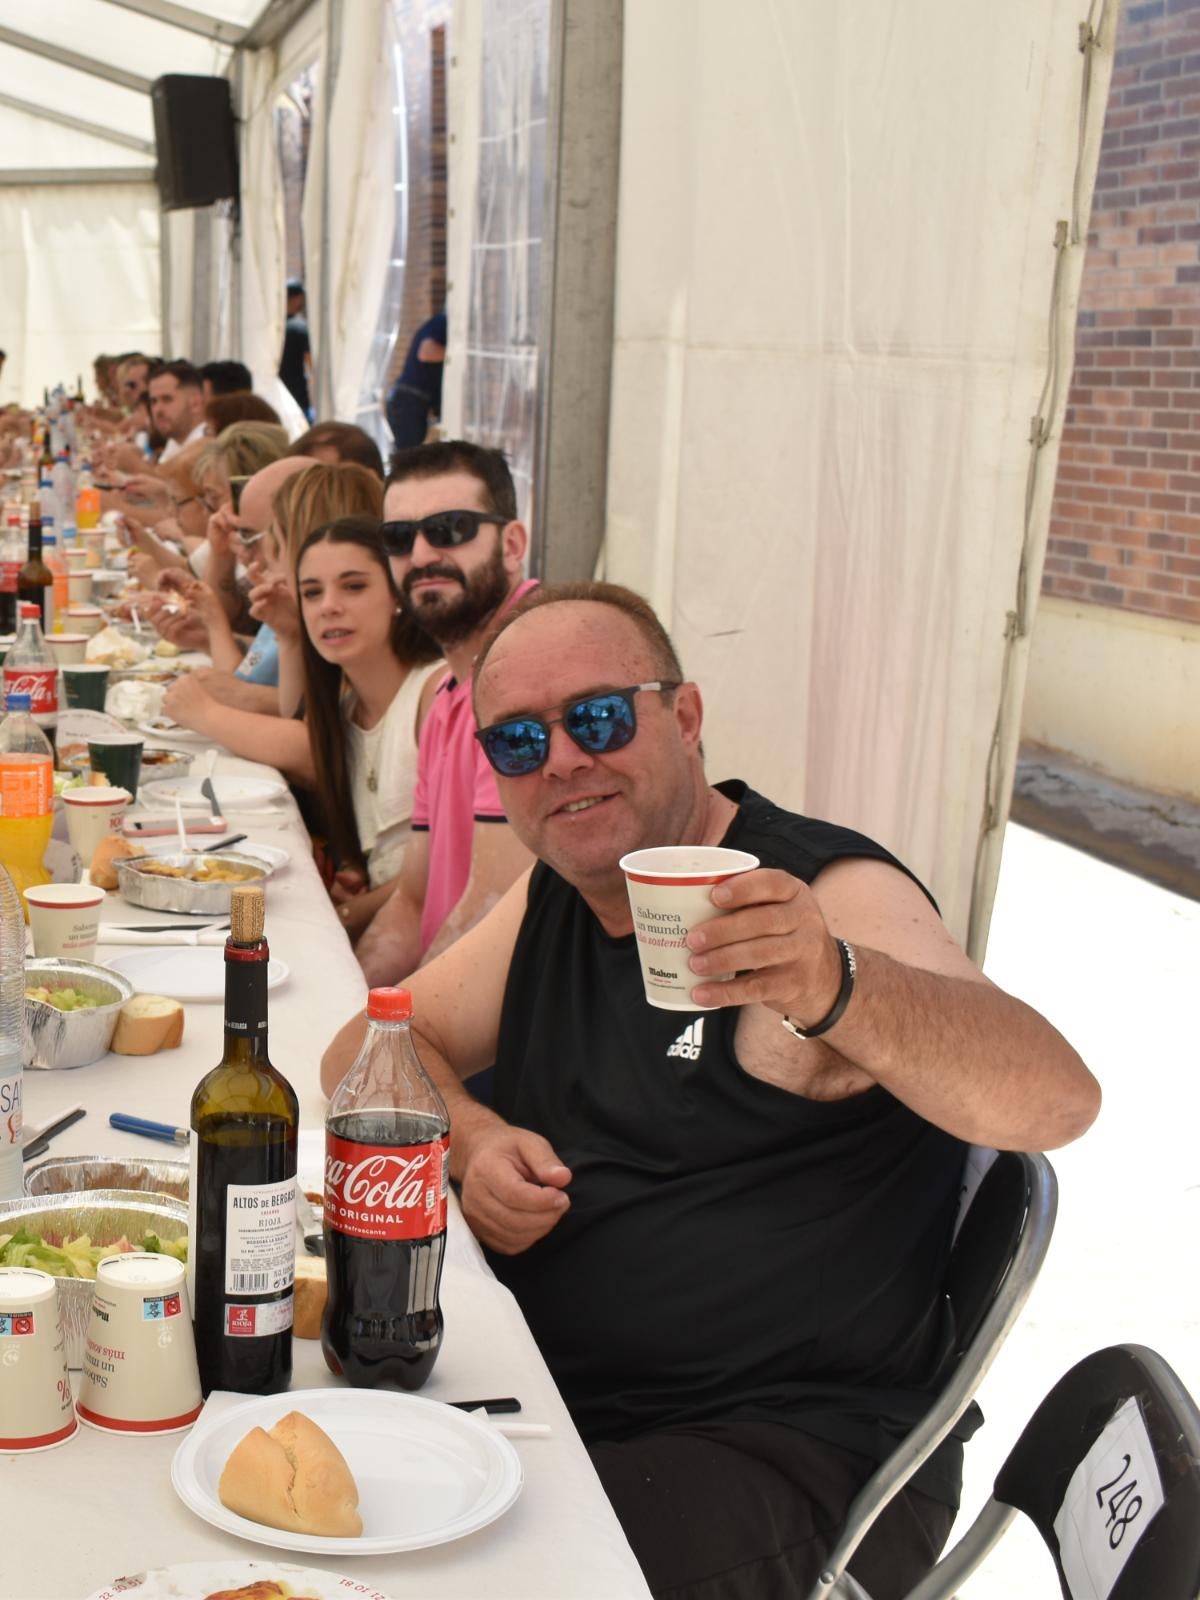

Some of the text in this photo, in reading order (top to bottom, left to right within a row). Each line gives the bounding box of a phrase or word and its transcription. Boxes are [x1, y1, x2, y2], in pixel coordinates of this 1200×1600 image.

[637, 906, 681, 923] Saborea
[647, 924, 688, 936] mundo
[649, 967, 678, 979] Mahou
[233, 1197, 259, 1209] ALTOS
[261, 1200, 269, 1208] DE
[258, 1217, 281, 1227] RIOJA
[340, 1208, 404, 1224] ORIGINAL
[344, 1224, 387, 1236] Refrescante
[103, 1347, 125, 1361] más
[101, 1361, 115, 1373] un
[1096, 1453, 1143, 1550] 248
